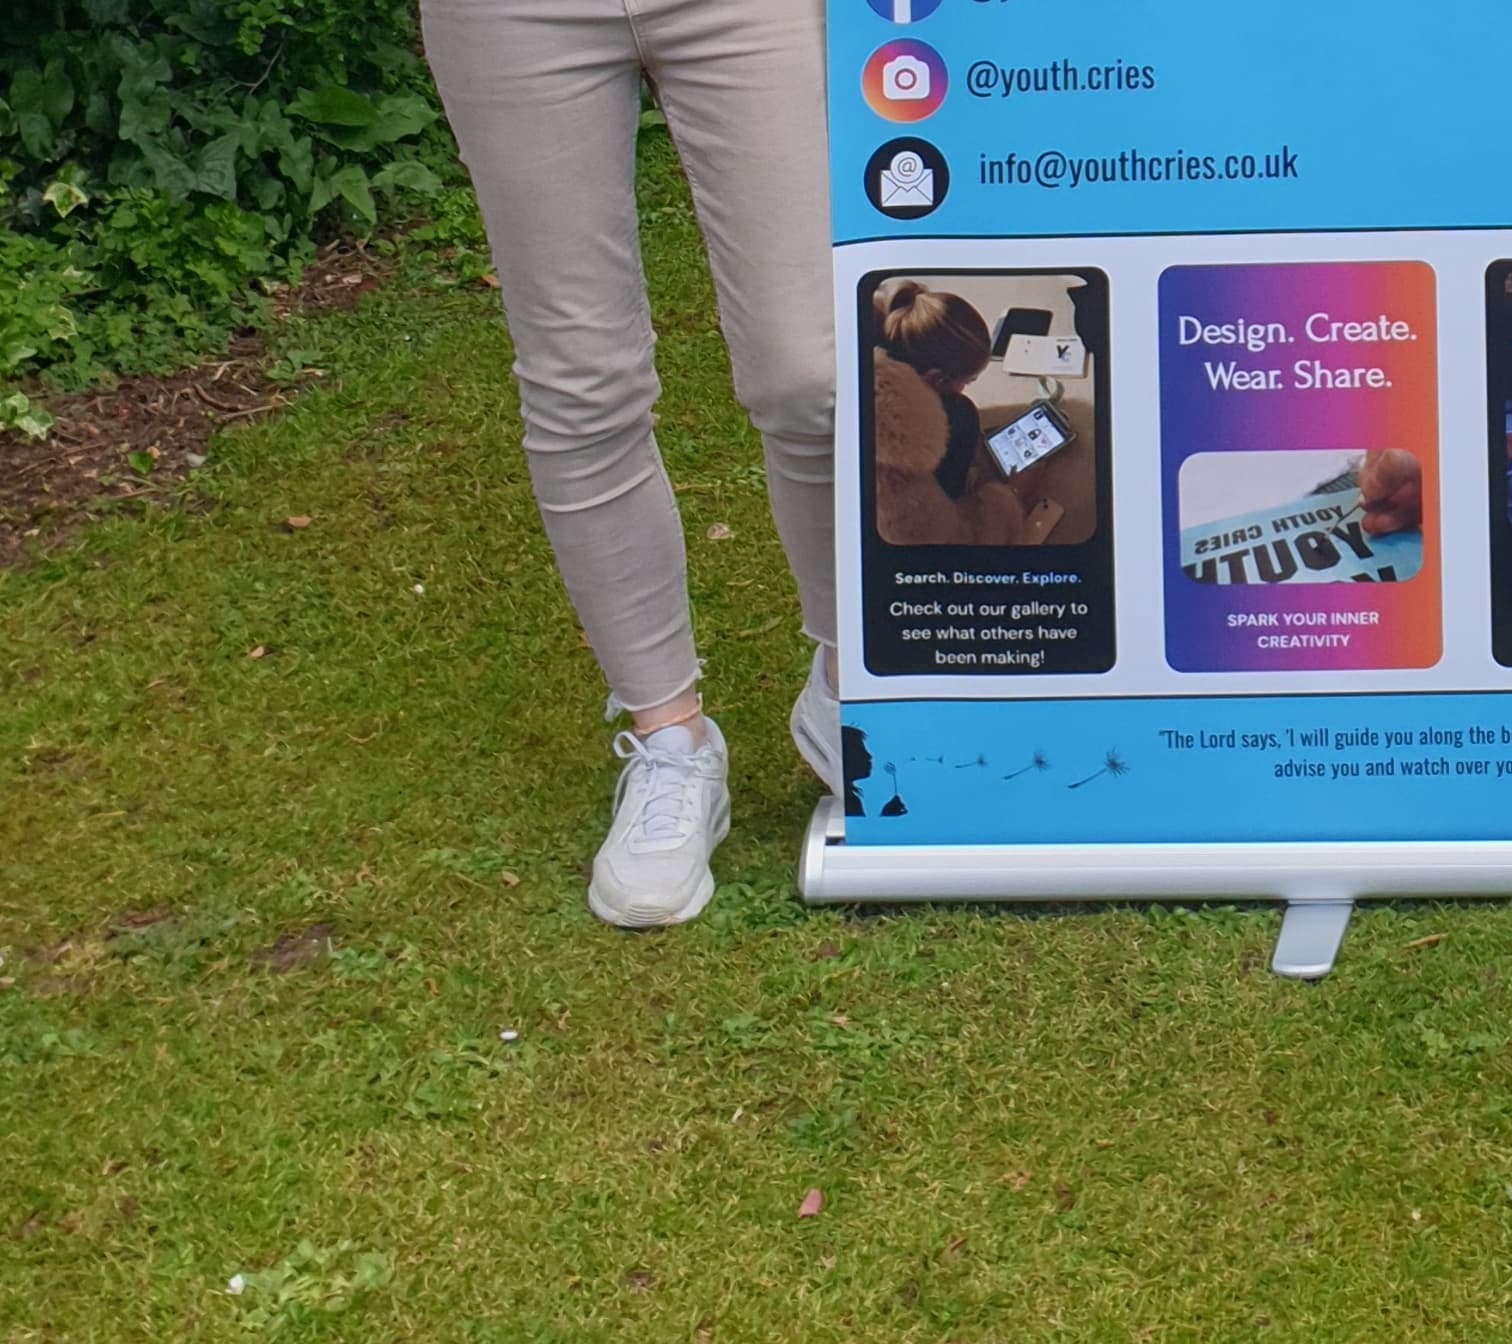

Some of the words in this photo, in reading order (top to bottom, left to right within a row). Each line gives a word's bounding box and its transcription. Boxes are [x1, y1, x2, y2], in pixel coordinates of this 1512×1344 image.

[966, 59, 1155, 98] @youth.cries
[979, 146, 1299, 189] info@youthcries.co.uk
[1178, 315, 1295, 352] Design.
[1305, 312, 1418, 343] Create.
[1204, 361, 1283, 391] Wear.
[1294, 359, 1393, 389] Share.
[895, 571, 950, 584] Search.
[953, 571, 1019, 584] Discover.
[1023, 572, 1081, 586] Explore.
[889, 601, 942, 616] Check
[947, 604, 974, 616] out
[979, 605, 1006, 616] our
[1011, 601, 1065, 619] gallery
[1071, 603, 1088, 615] to
[1227, 614, 1279, 627] SPARK
[1283, 613, 1327, 626] YOUR
[1331, 612, 1379, 625] INNER
[902, 629, 931, 640] see
[936, 626, 975, 640] what
[980, 626, 1033, 640] others
[1038, 626, 1078, 639] have
[1257, 634, 1350, 648] CREATIVITY
[935, 651, 977, 664] been
[981, 650, 1045, 668] making!
[1200, 729, 1236, 749] Lord
[1241, 732, 1281, 751] says,
[1300, 728, 1329, 747] will
[1334, 727, 1379, 750] guide
[1384, 731, 1413, 749] you
[1419, 726, 1464, 748] along
[1468, 725, 1496, 745] the
[1274, 758, 1326, 778] advise
[1331, 761, 1360, 780] you
[1365, 757, 1395, 776] and
[1400, 757, 1449, 776] watch
[1455, 758, 1490, 775] over
